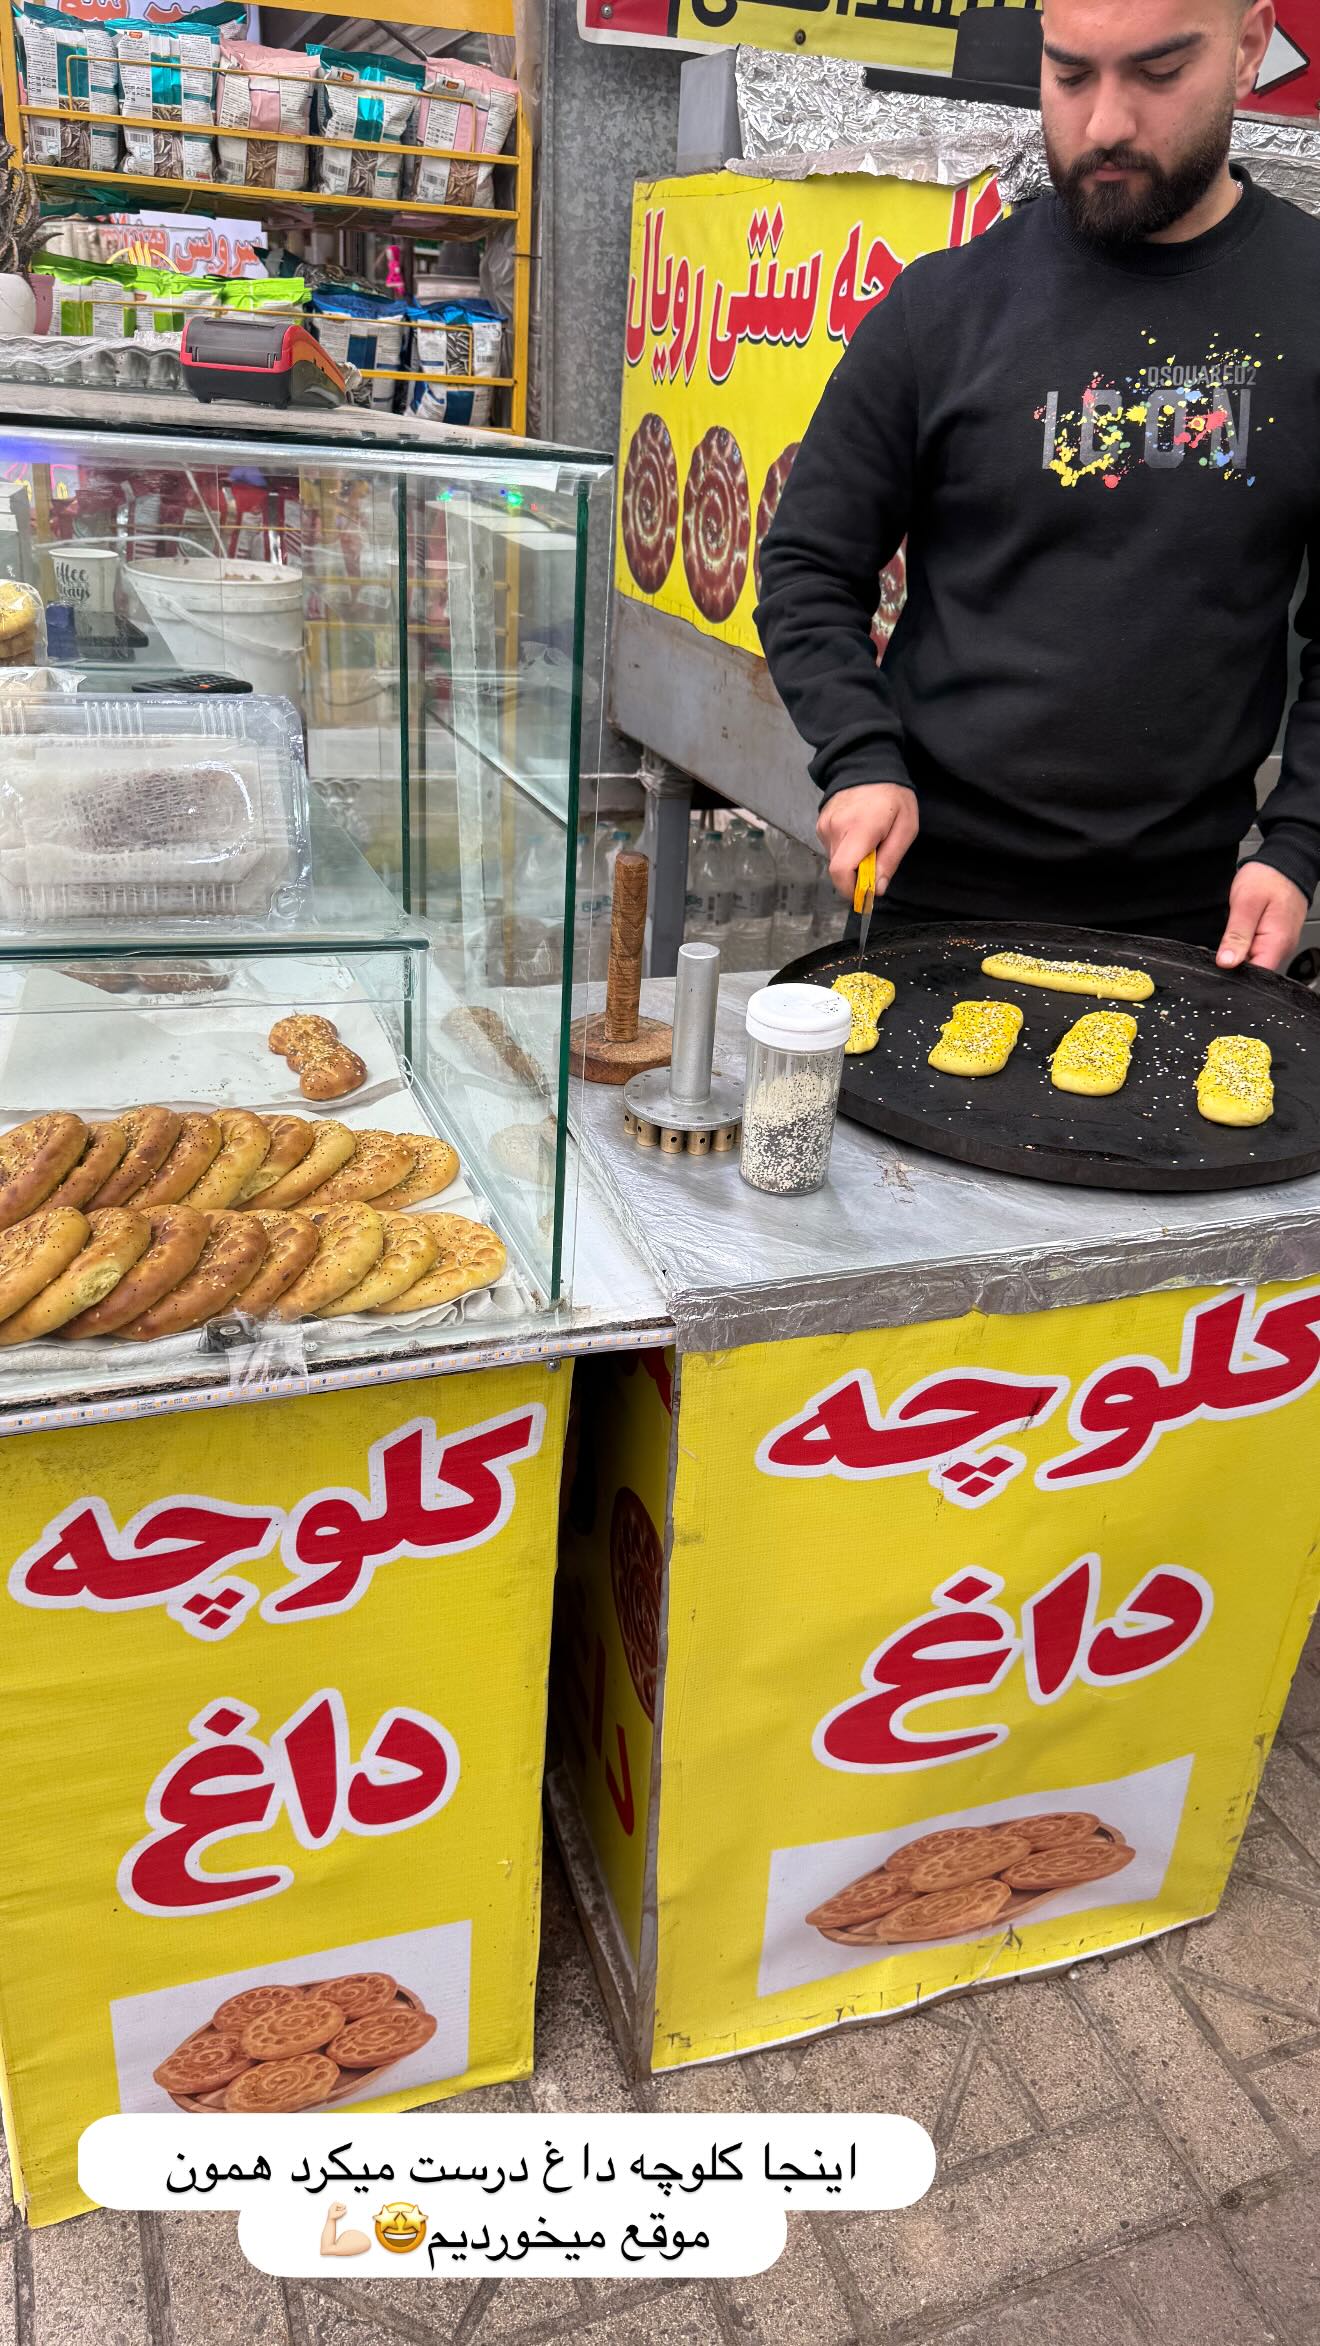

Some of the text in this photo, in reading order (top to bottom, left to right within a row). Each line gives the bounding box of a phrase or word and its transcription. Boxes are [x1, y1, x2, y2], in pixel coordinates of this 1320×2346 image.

[625, 208, 704, 385] رویال
[708, 203, 822, 384] سنتی
[1041, 389, 1251, 470] ICON
[755, 1285, 1320, 1506] کلوچه
[12, 1406, 542, 1637] کلوچه
[815, 1556, 1212, 1772] داغ
[120, 1690, 458, 1914] داغ
